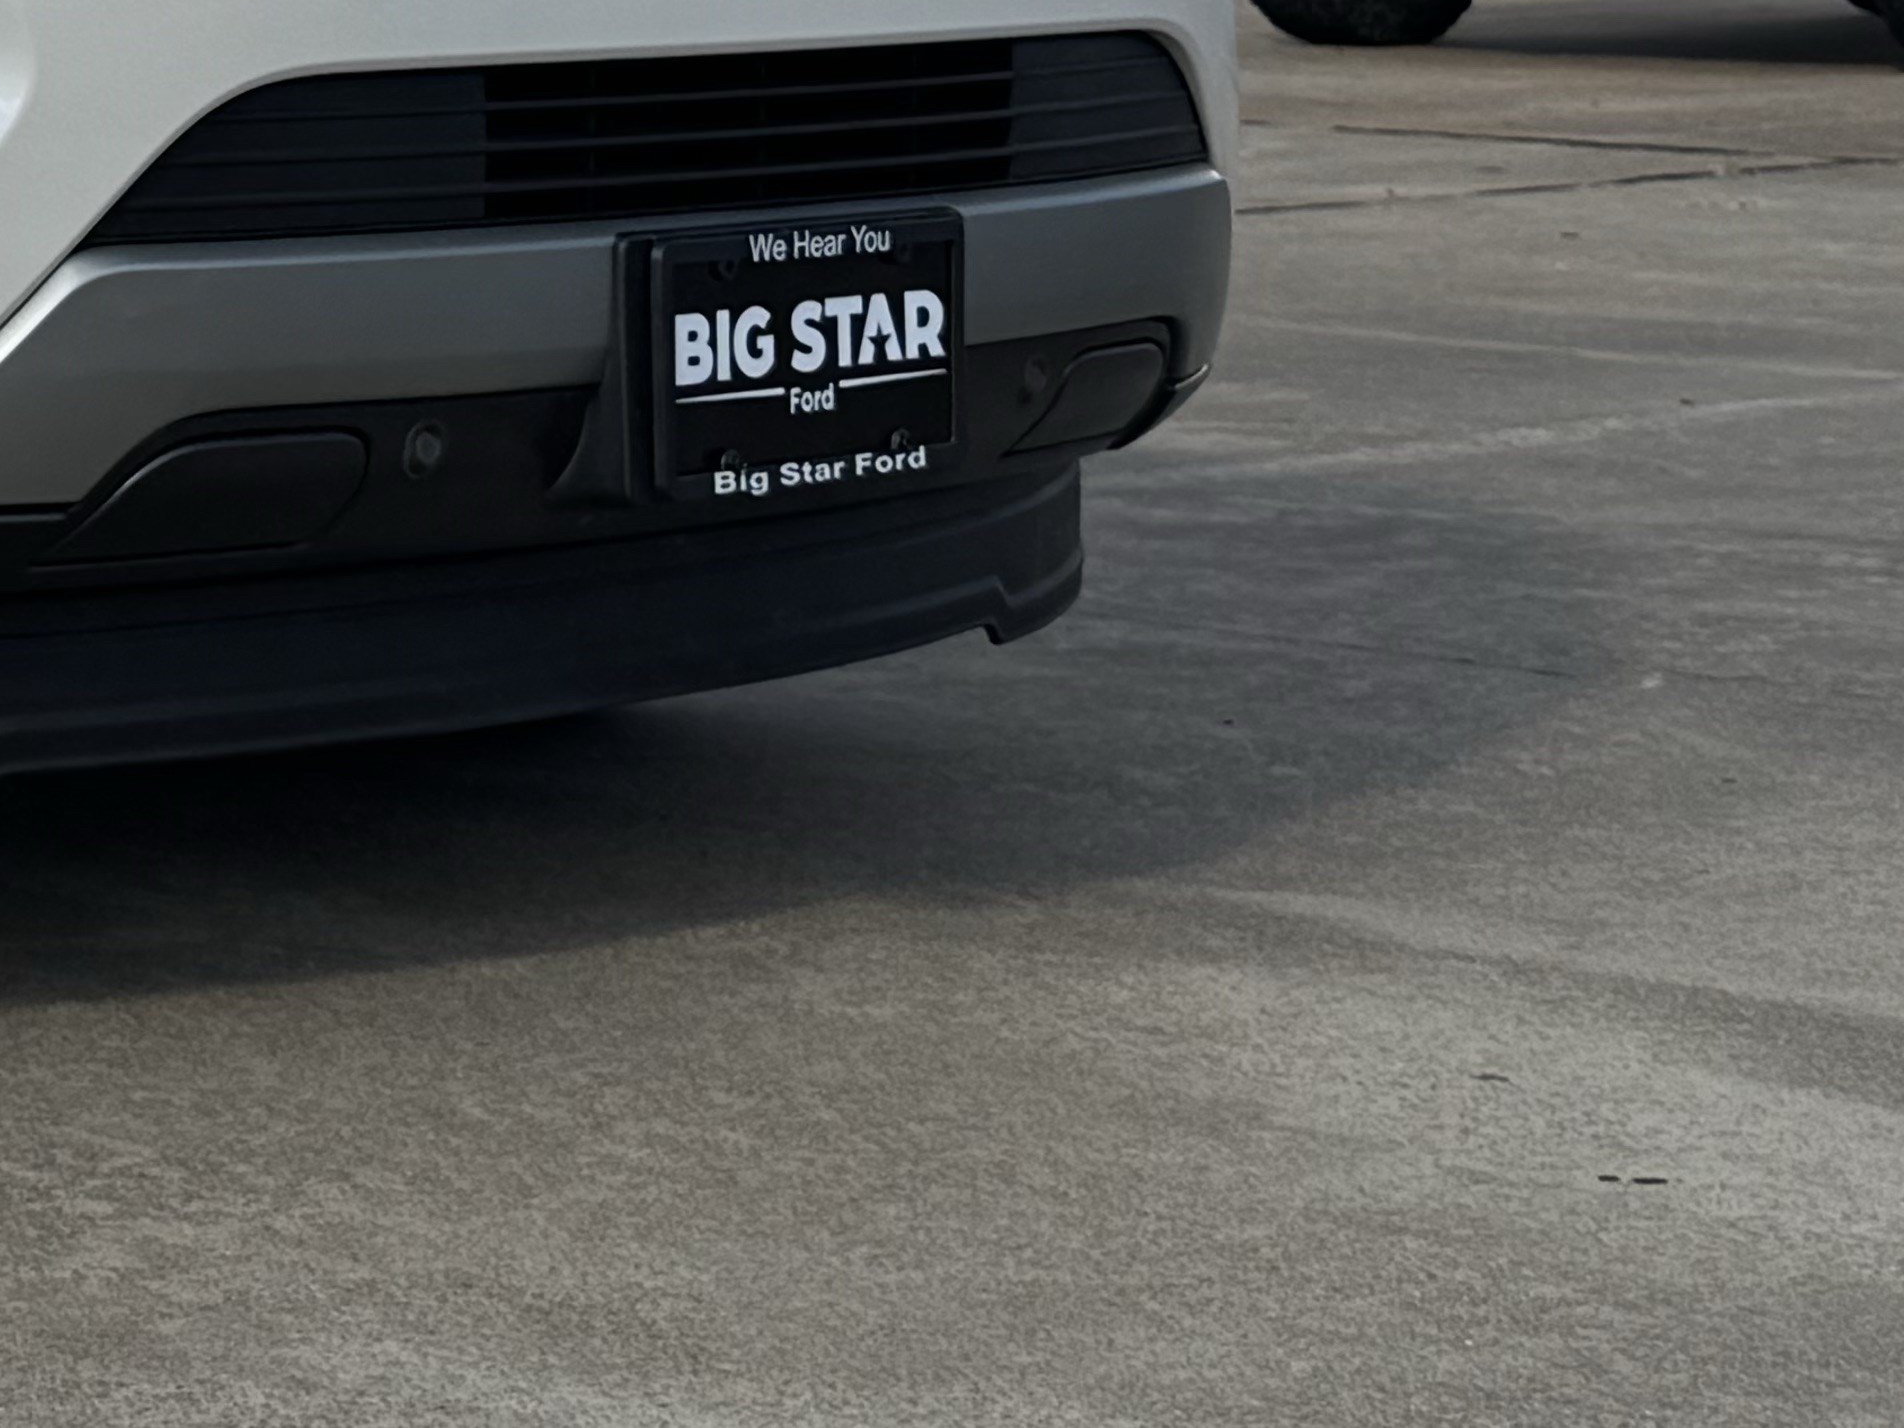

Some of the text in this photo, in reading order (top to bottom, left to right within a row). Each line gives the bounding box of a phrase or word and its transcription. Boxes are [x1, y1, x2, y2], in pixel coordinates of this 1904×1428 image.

[748, 224, 891, 263] We Hear You
[674, 289, 946, 387] BIG STAR
[789, 382, 835, 414] Ford
[713, 444, 928, 497] Big Star Ford
